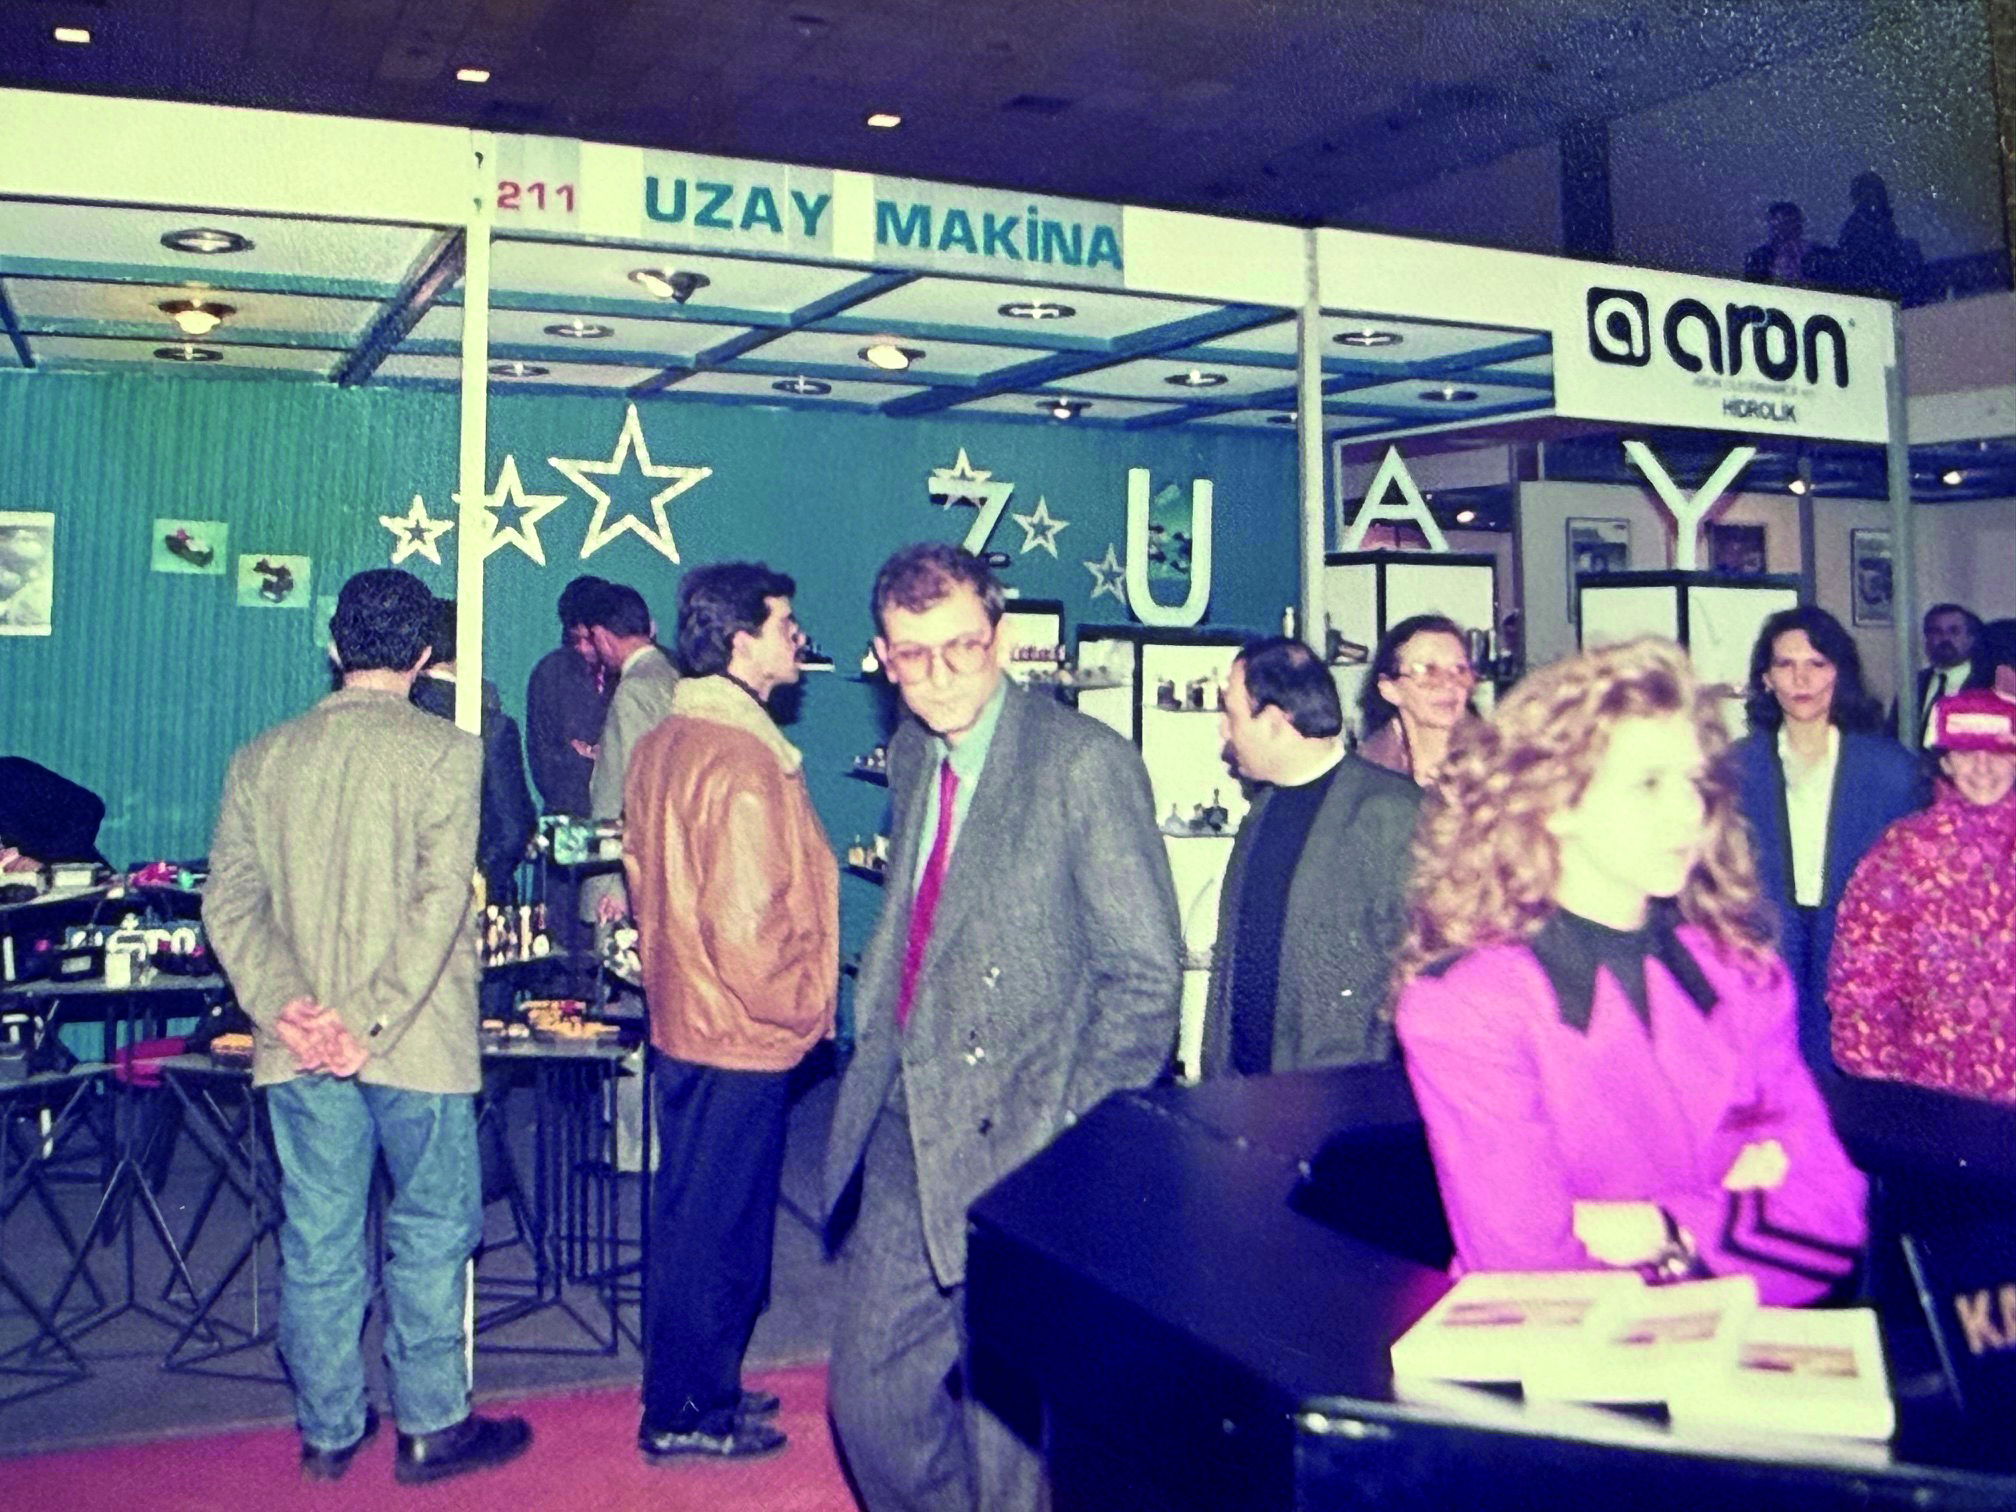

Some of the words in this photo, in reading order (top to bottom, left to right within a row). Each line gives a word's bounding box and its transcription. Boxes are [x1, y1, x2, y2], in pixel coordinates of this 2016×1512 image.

[496, 180, 575, 213] 211
[644, 175, 832, 237] UZAY
[875, 200, 1125, 271] MAKİNA
[1662, 297, 1850, 389] aron
[1341, 444, 1451, 554] A
[1623, 440, 1757, 571] Y
